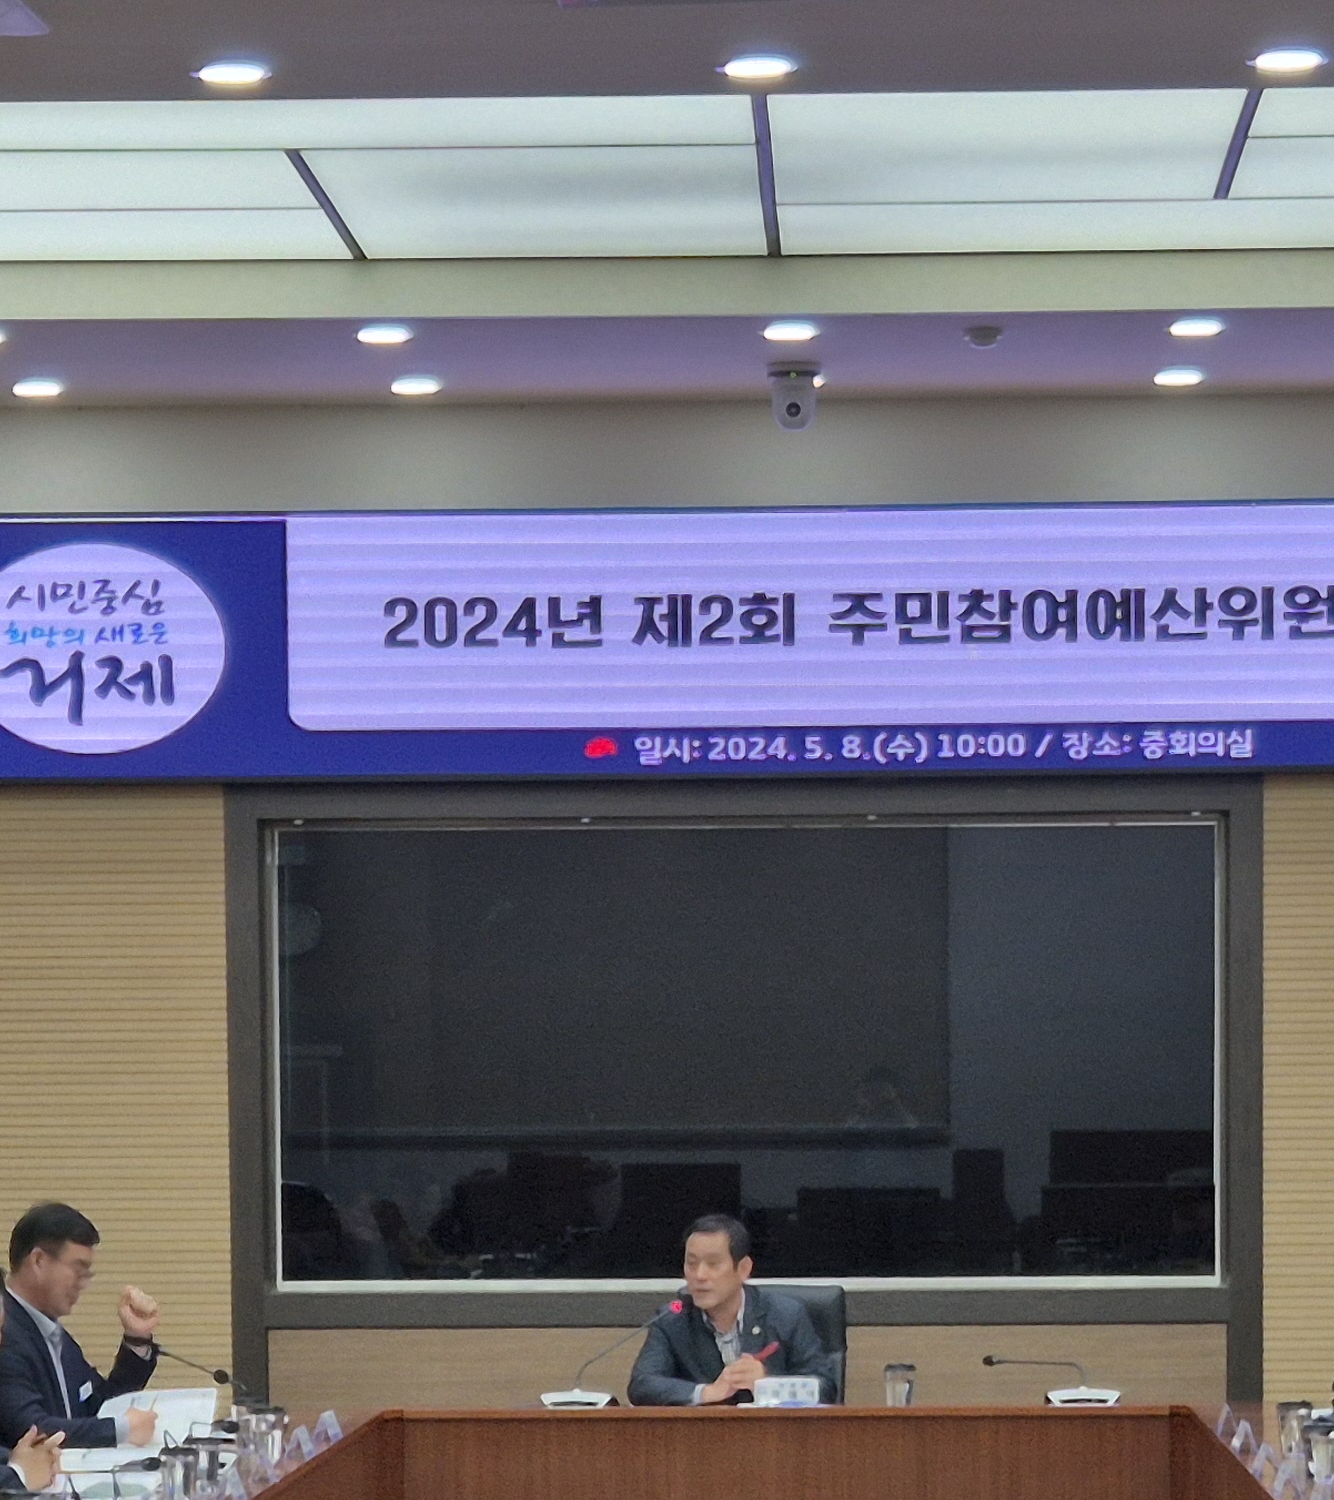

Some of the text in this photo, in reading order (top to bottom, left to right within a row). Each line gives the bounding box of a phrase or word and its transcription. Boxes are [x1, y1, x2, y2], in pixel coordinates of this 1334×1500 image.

[5, 578, 166, 617] 시민중심
[4, 619, 169, 648] 희망의 새로운
[382, 593, 604, 649] 2024년
[631, 591, 796, 648] 제2회
[633, 734, 702, 766] 일시:
[707, 735, 797, 762] 2024.
[803, 735, 833, 762] 5.
[936, 732, 1026, 759] 10:00
[1034, 731, 1055, 759] /
[1063, 731, 1133, 761] 장소:
[1139, 729, 1255, 760] 중회의실
